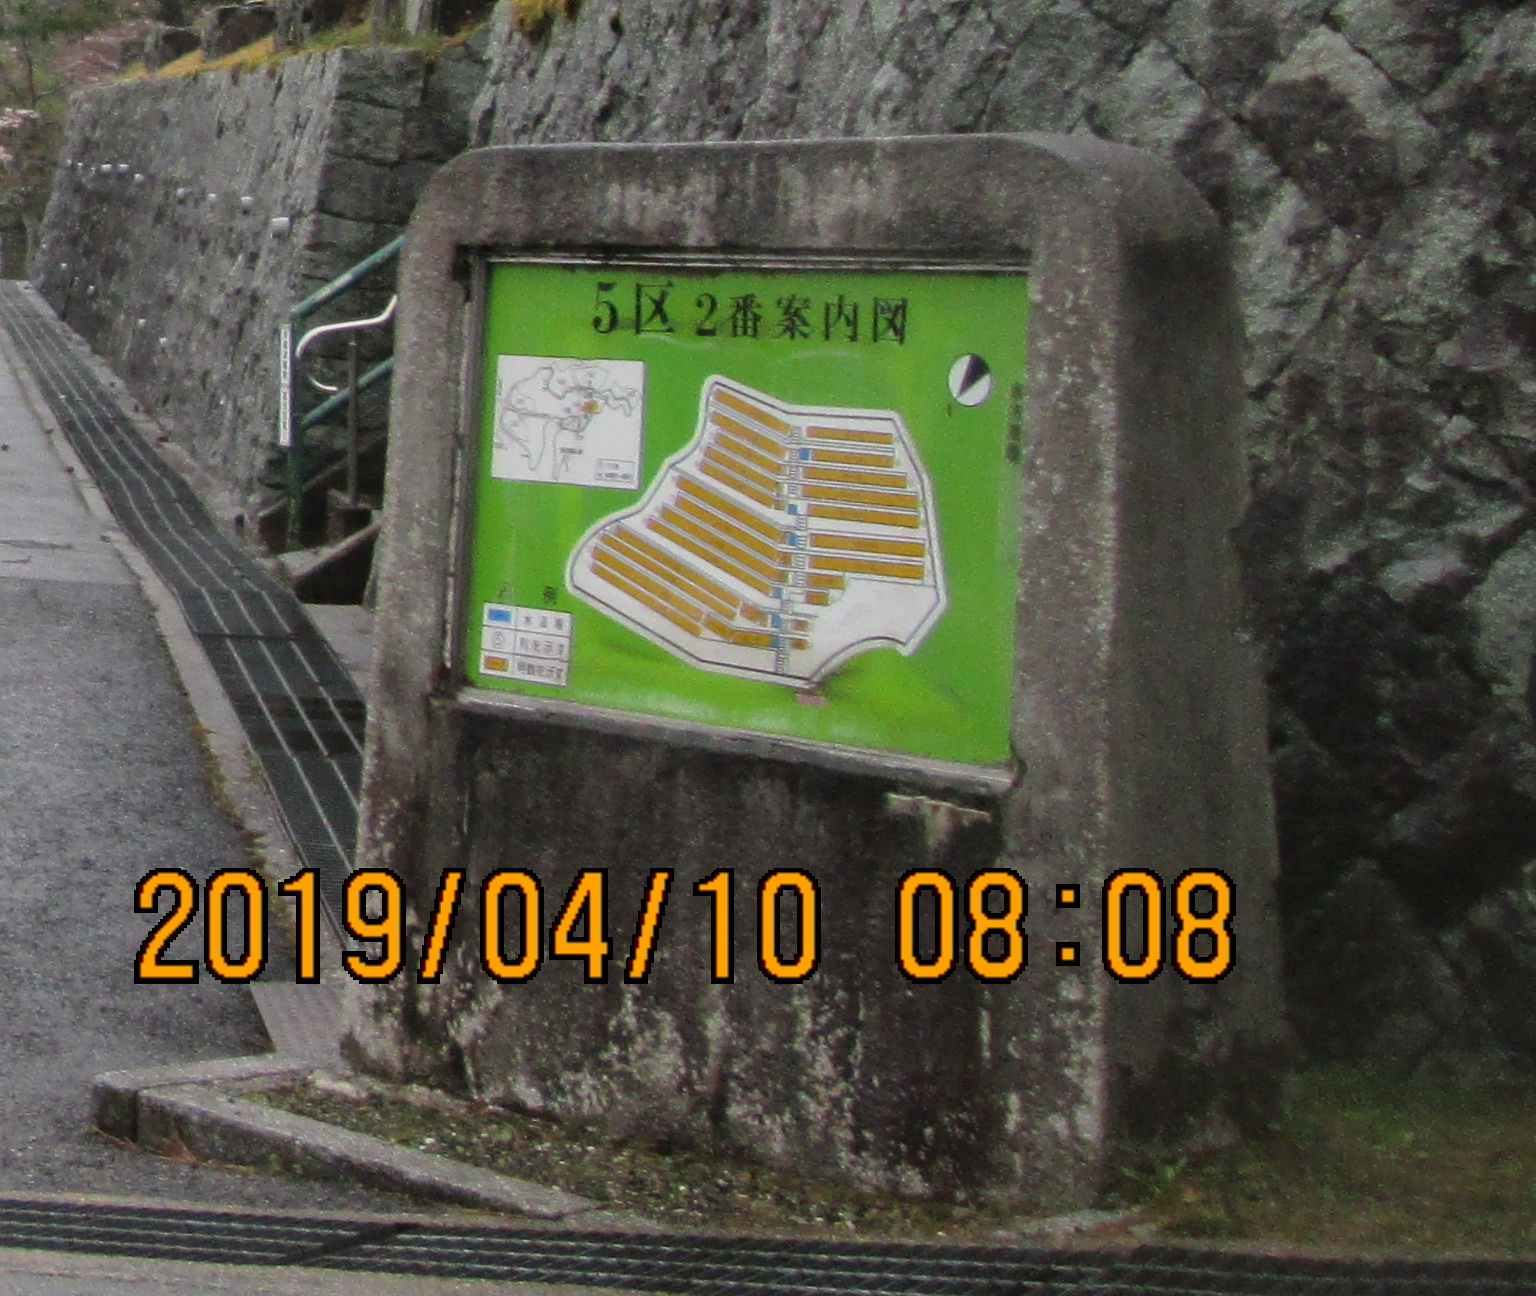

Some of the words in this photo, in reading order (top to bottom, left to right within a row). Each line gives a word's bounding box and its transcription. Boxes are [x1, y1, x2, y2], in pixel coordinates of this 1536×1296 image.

[592, 281, 908, 345] 5区2番案内図
